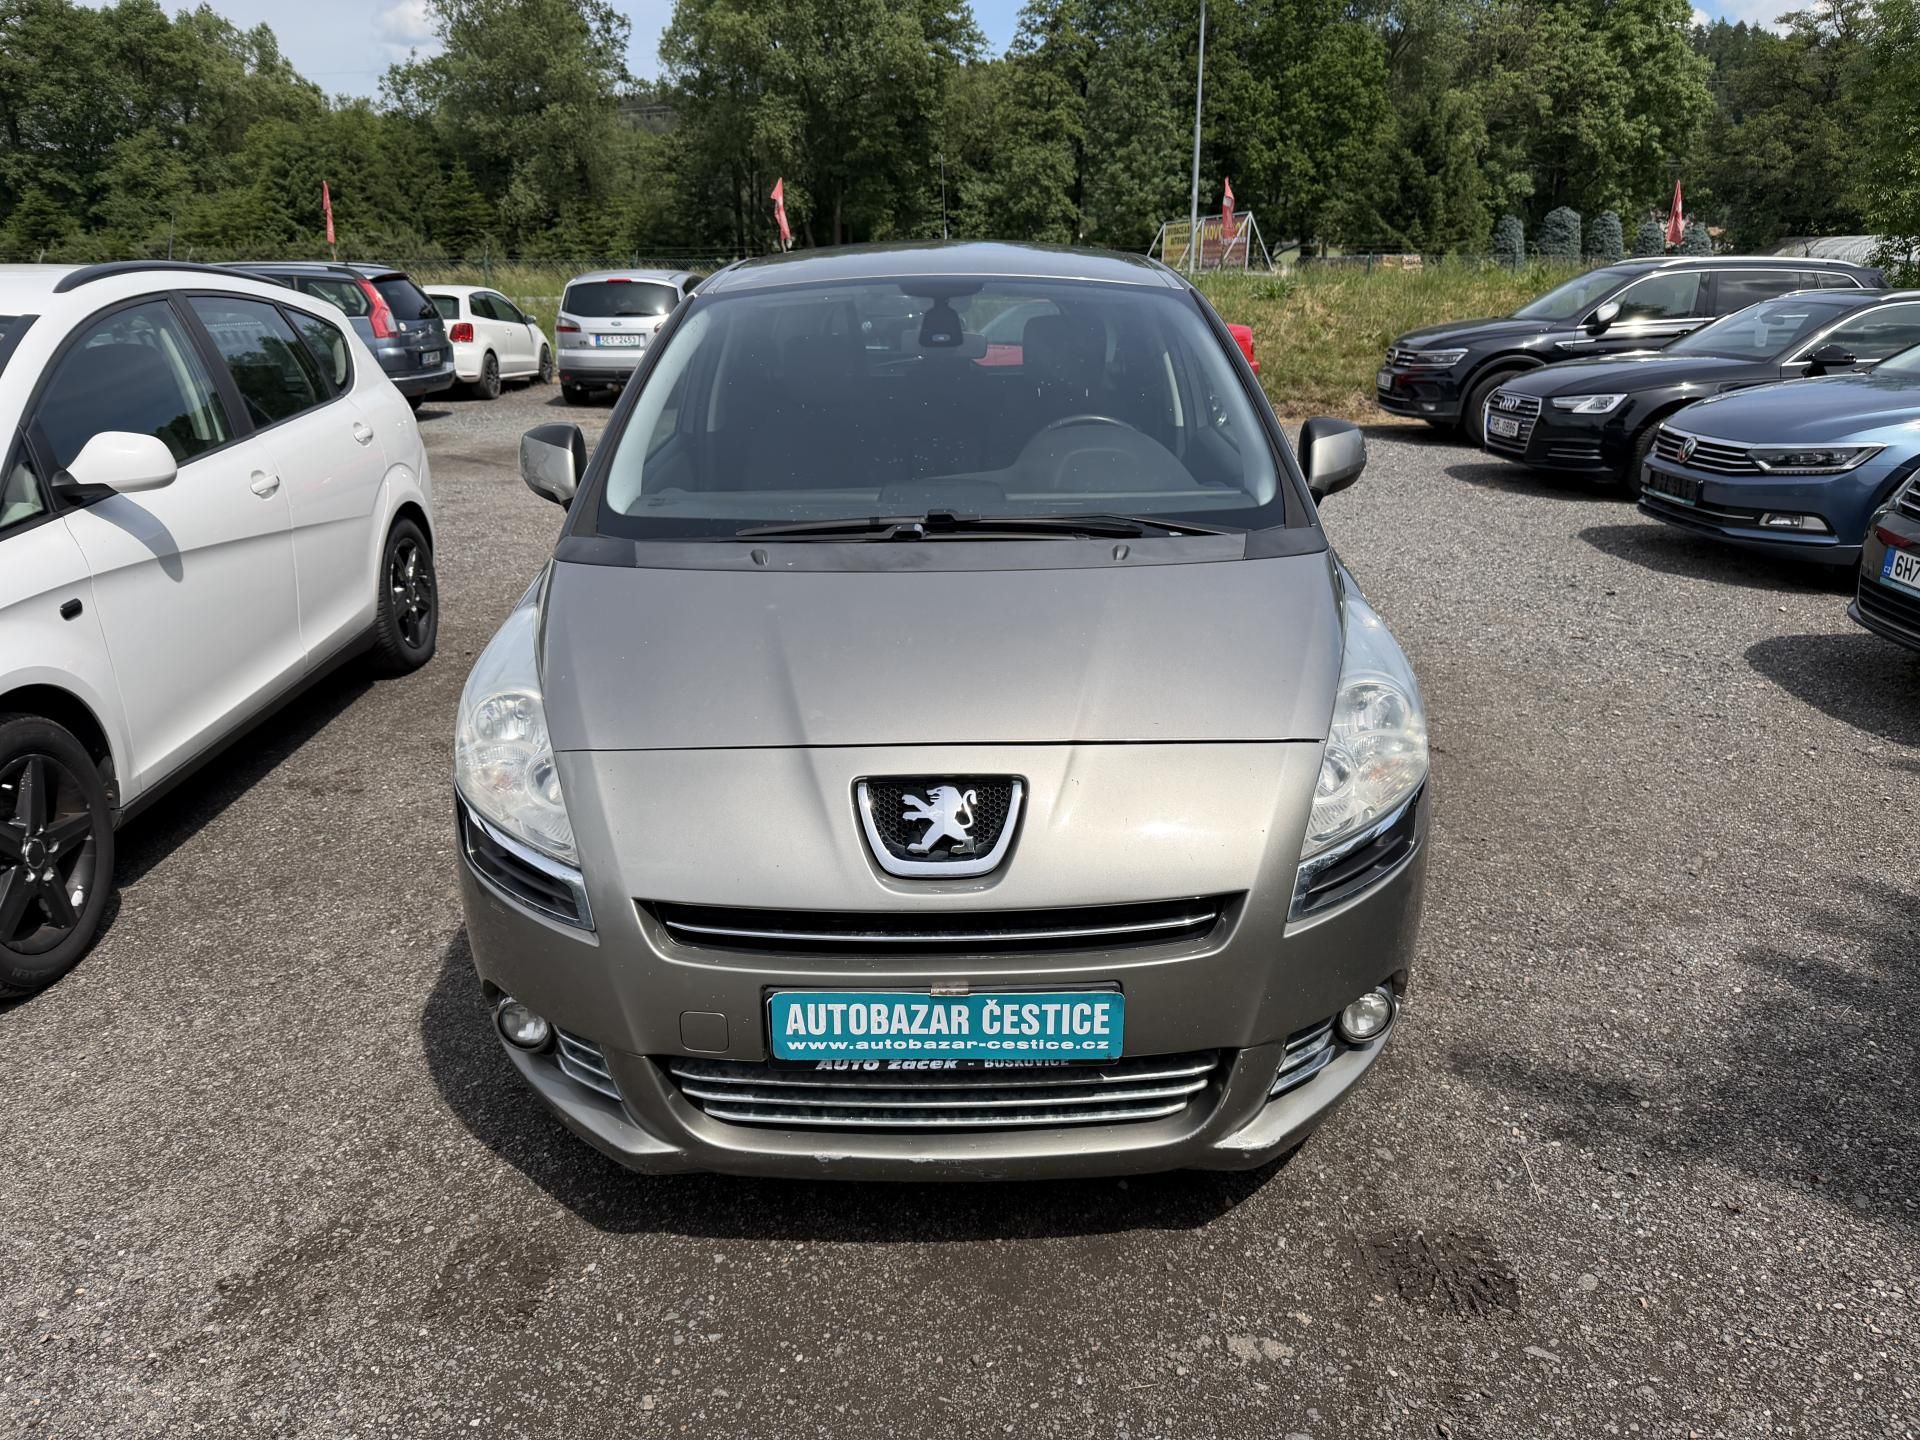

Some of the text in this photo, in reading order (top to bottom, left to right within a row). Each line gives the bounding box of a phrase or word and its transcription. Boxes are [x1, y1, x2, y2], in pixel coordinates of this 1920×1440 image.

[785, 999, 1110, 1036] AUTOBAZAR ČESTICE
[786, 1039, 1109, 1050] www.autobazar-cestice.cz
[815, 1059, 880, 1070] AUTO
